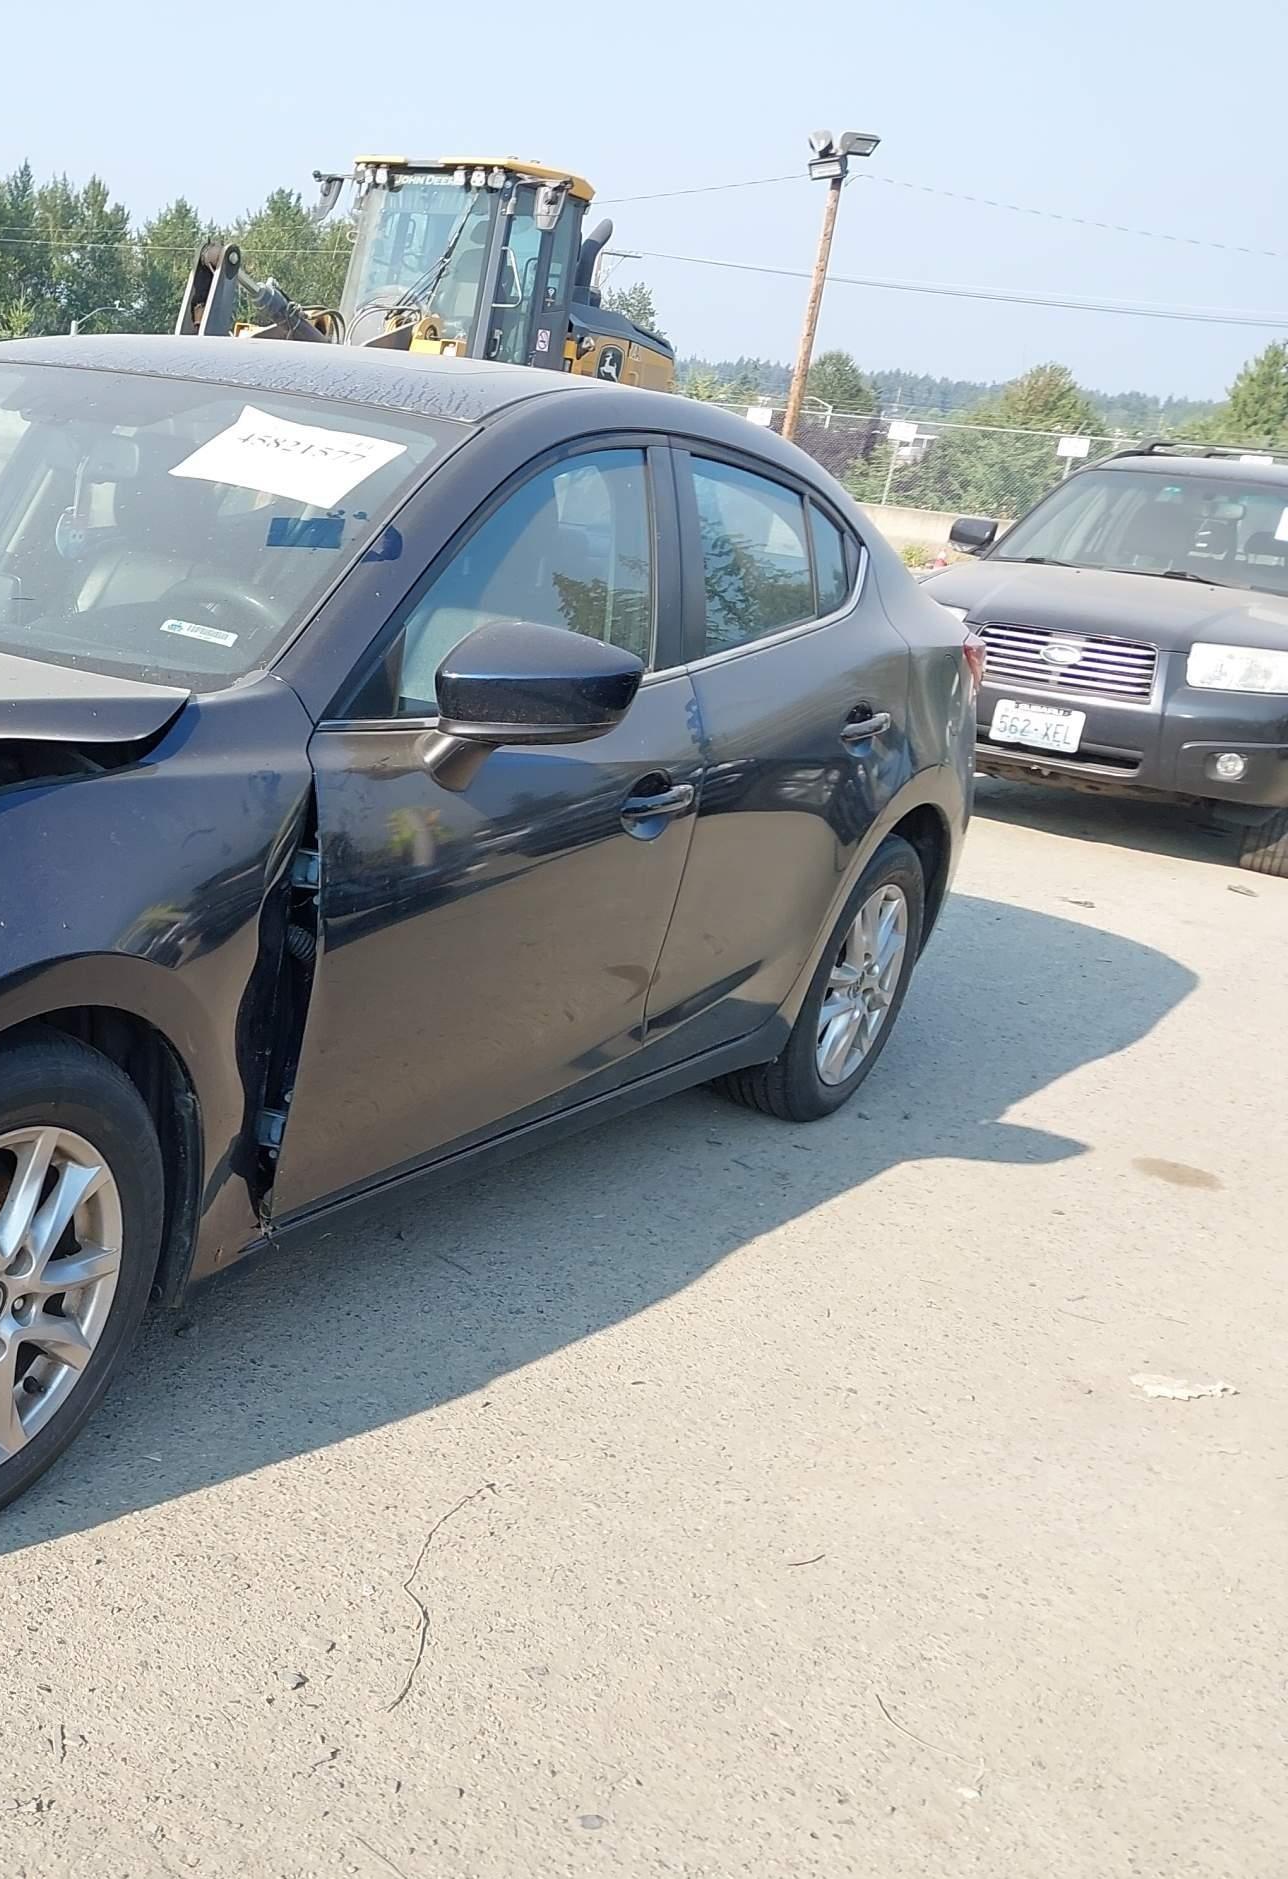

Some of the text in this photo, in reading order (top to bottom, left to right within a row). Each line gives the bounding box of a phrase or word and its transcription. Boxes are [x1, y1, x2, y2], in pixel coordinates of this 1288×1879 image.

[394, 174, 455, 185] JOHN DEER
[238, 433, 367, 463] 45821577
[997, 713, 1072, 745] 562-XEL
